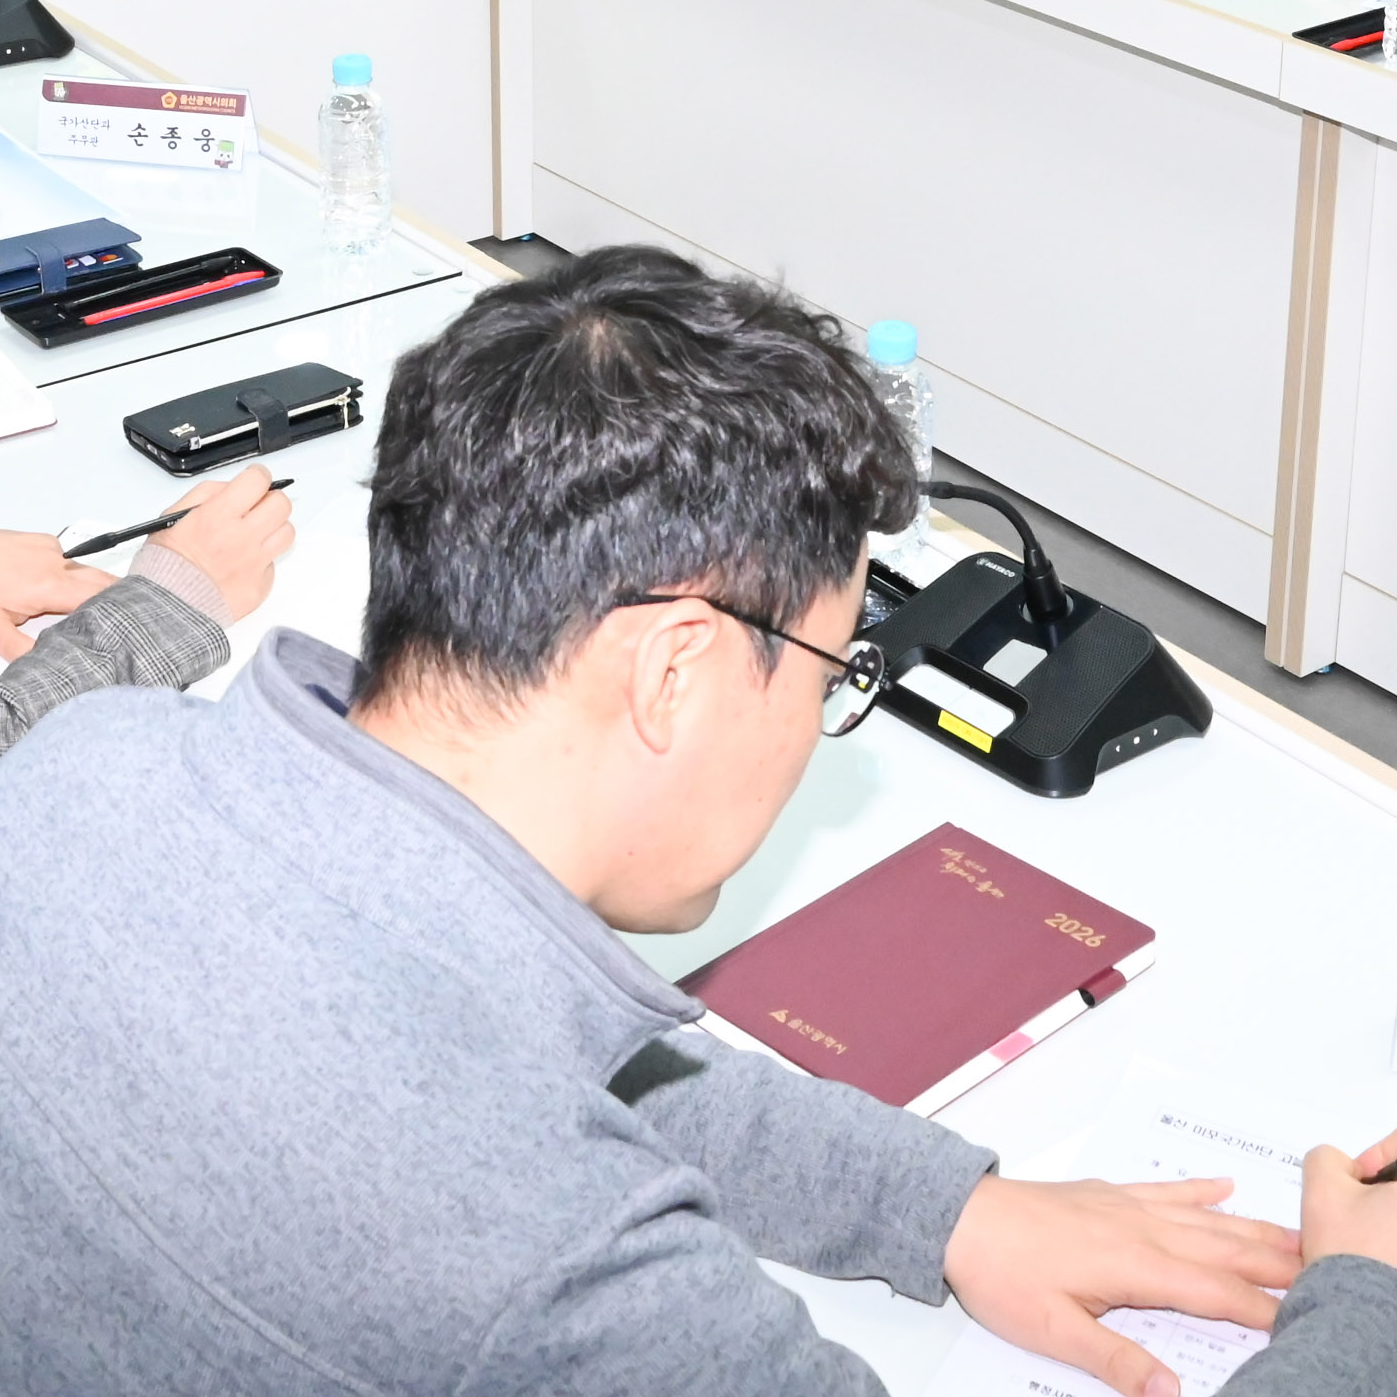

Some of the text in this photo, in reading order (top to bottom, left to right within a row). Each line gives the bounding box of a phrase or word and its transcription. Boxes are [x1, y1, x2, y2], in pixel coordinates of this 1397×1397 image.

[178, 94, 237, 109] 울산광역시의회
[59, 116, 111, 131] 국가산단과
[1043, 912, 1107, 949] 2026
